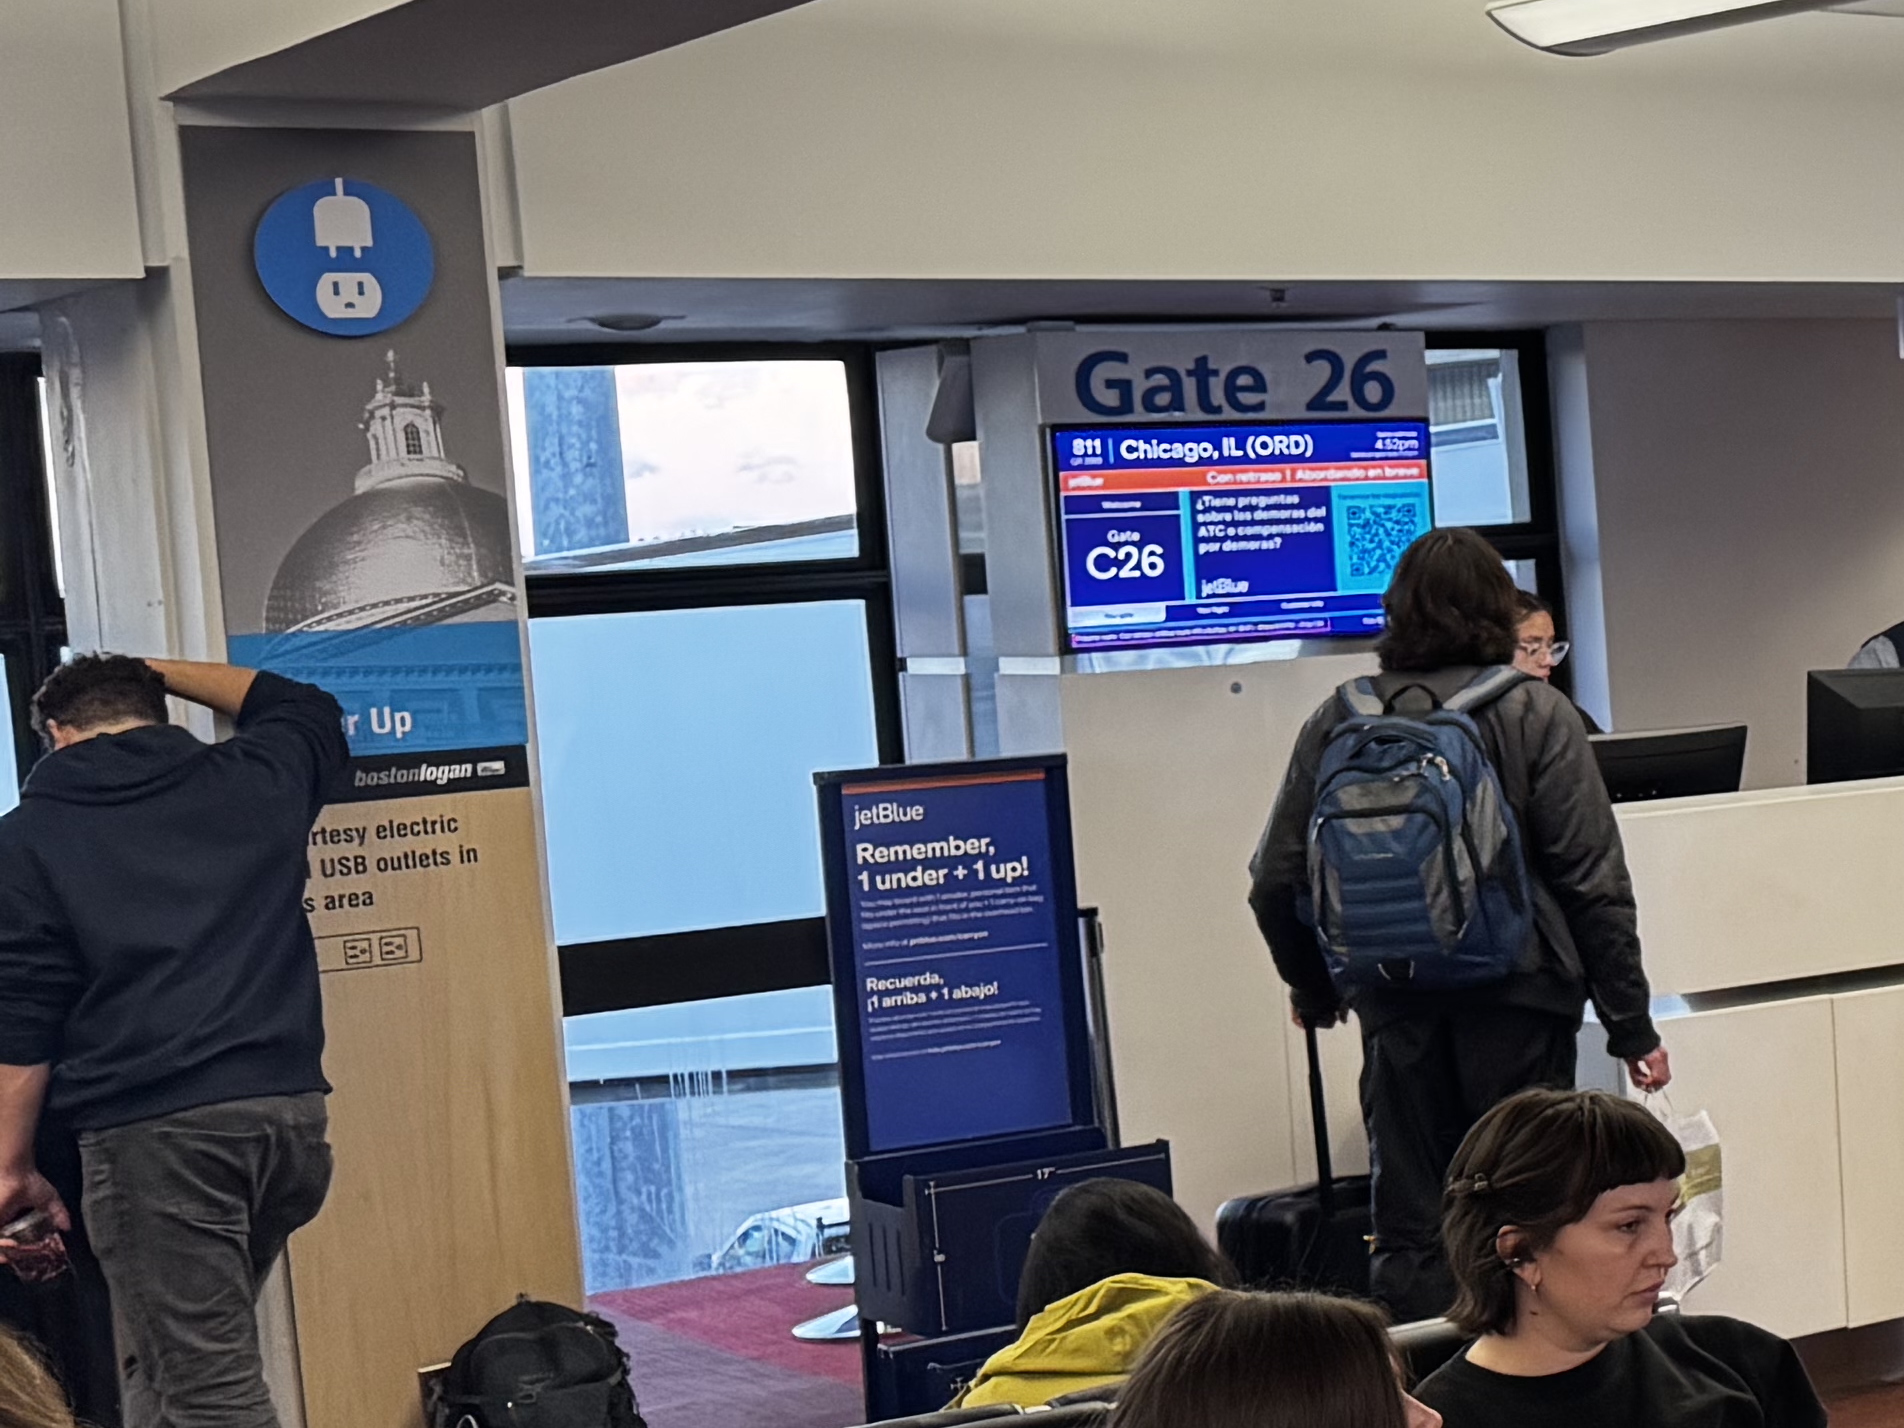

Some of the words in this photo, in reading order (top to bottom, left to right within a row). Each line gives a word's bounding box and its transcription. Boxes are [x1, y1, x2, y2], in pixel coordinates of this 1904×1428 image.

[1074, 350, 1268, 417] Gate
[1303, 349, 1396, 413] 26
[1071, 437, 1102, 456] 811
[1119, 438, 1219, 463] Chicago,
[1221, 436, 1244, 457] IL
[1246, 434, 1314, 459] (ORD)
[1198, 525, 1226, 538] ATC
[1085, 543, 1165, 580] C26
[370, 706, 412, 739] Up
[354, 762, 473, 786] bostonlogan
[311, 825, 367, 847] rtesy
[376, 814, 459, 840] electric
[854, 802, 924, 830] jetBlue
[320, 855, 368, 879] USB
[376, 848, 452, 874] outlets
[459, 844, 479, 864] in
[856, 835, 996, 865] Remember,
[857, 870, 870, 892] 1
[875, 865, 949, 891] under
[952, 865, 968, 880] +
[972, 859, 985, 881] 1
[990, 855, 1030, 883] up!
[323, 890, 374, 911] area
[865, 972, 944, 992] Recuerda,
[882, 991, 927, 1008] arriba
[952, 981, 999, 1000] abajo!
